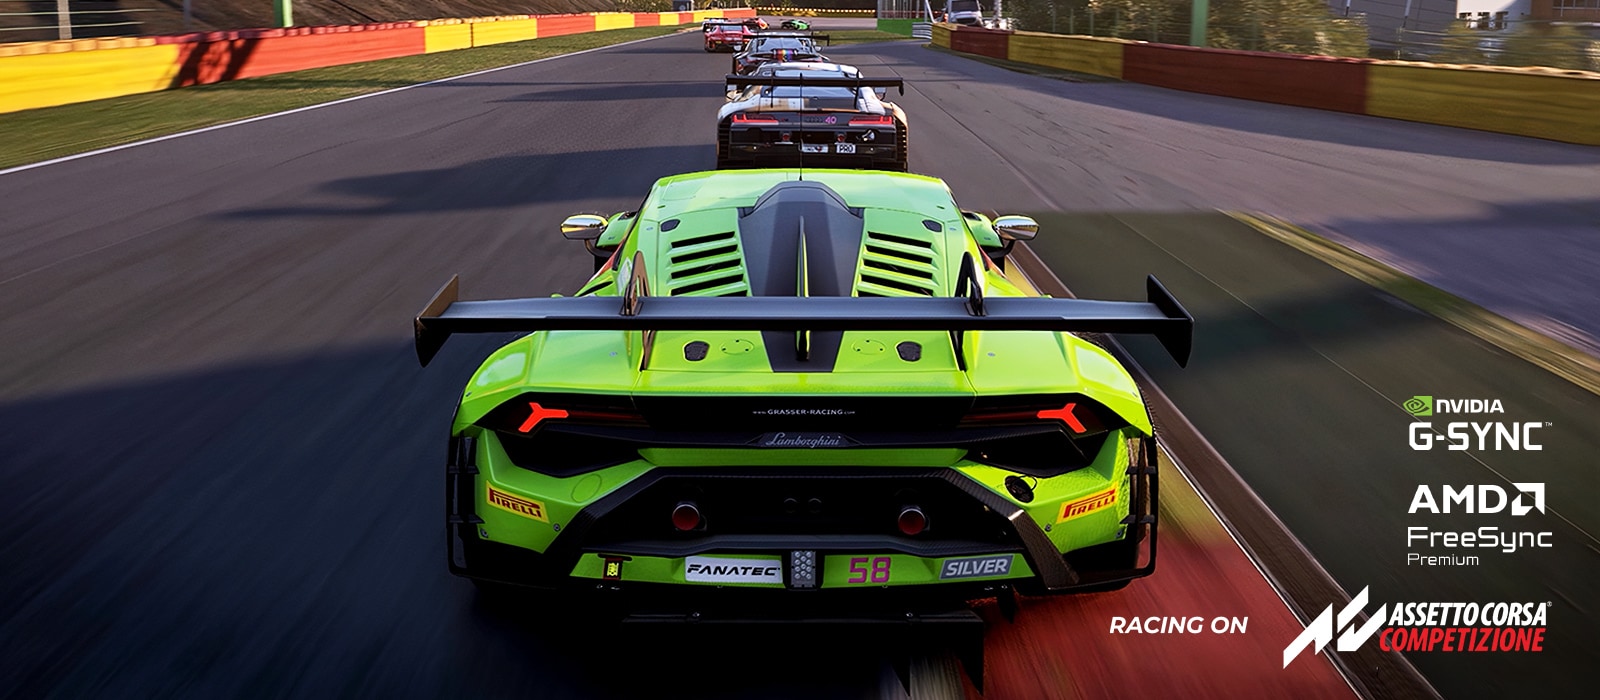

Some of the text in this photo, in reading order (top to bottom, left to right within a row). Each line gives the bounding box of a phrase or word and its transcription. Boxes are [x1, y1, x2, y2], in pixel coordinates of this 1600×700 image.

[824, 116, 838, 125] 40
[839, 144, 854, 152] PRO
[765, 432, 841, 449] Lamborghini
[489, 487, 543, 518] PIRELLI
[1063, 488, 1116, 519] PIRELLI
[687, 564, 778, 576] FANATEC
[848, 557, 891, 583] 58
[945, 558, 1008, 576] SILVER
